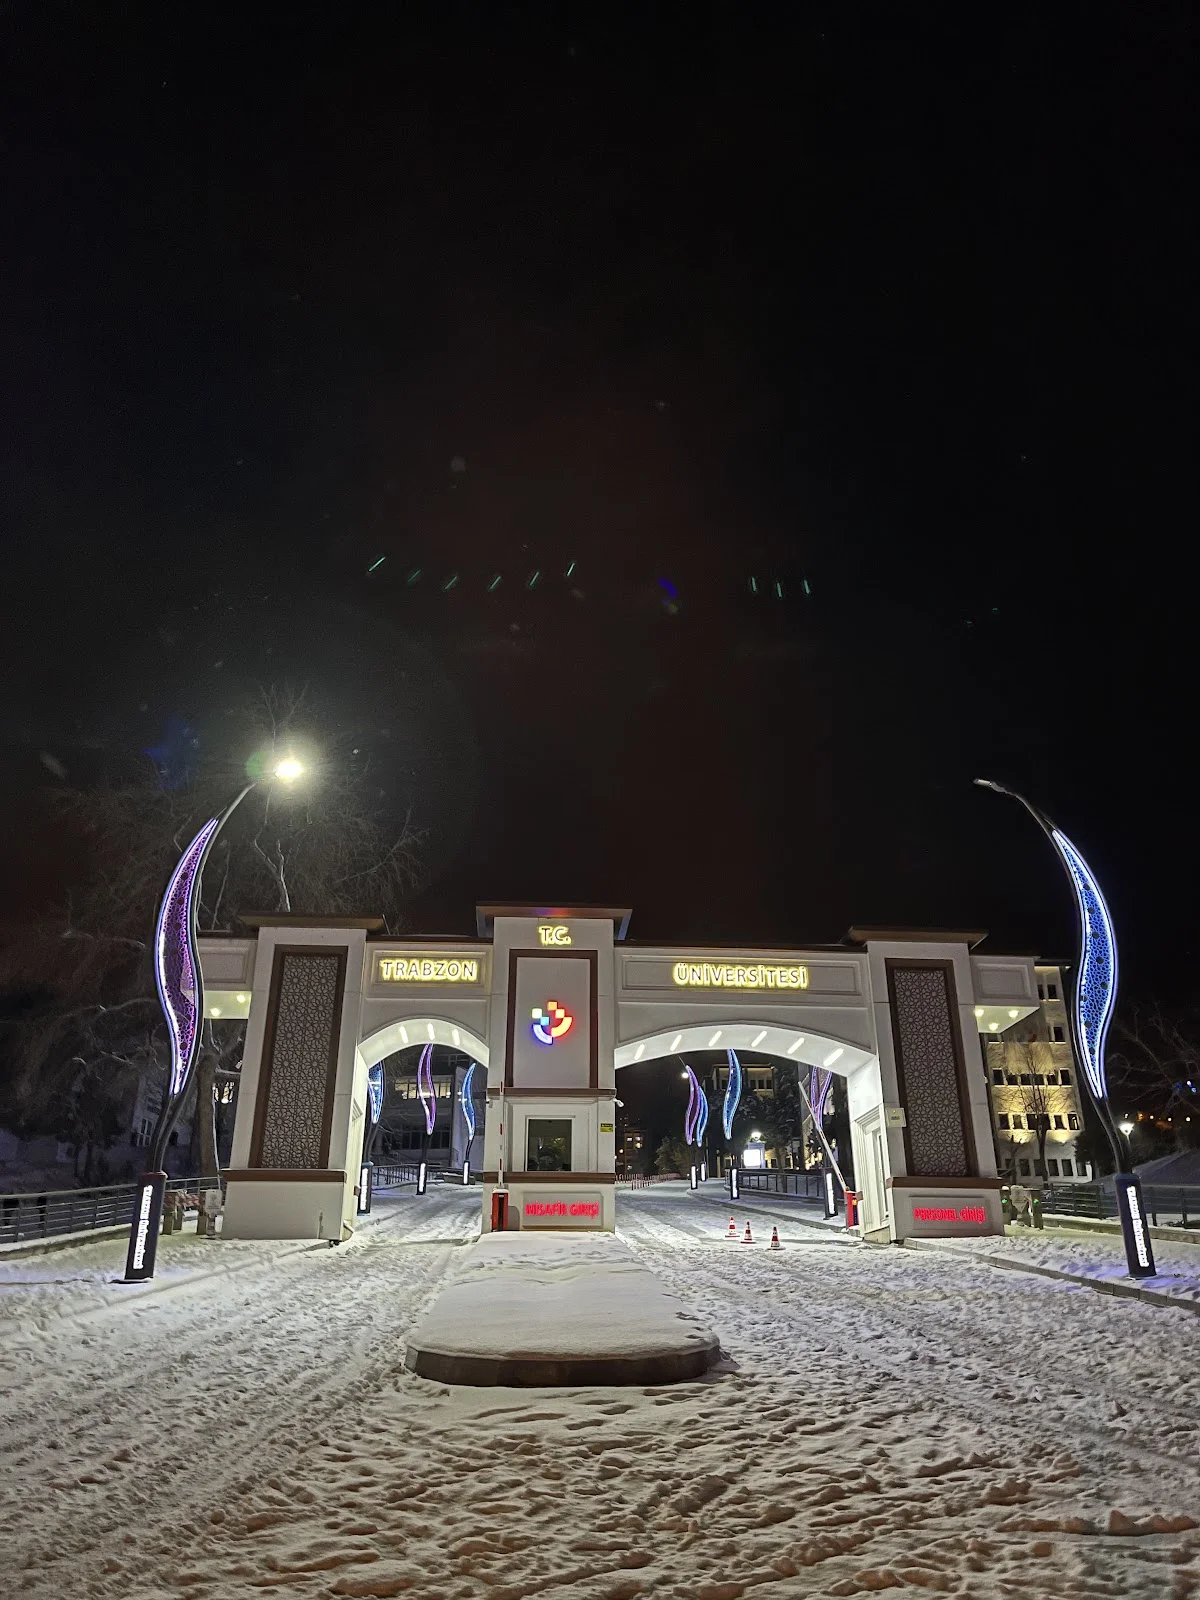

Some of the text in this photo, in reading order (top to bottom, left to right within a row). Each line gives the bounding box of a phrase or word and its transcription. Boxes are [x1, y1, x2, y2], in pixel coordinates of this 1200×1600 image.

[538, 925, 571, 945] T.C.
[379, 959, 478, 981] TRABZON
[673, 962, 808, 989] ÜNİVERSİTESİ
[569, 1200, 599, 1219] GİRİŞİ
[913, 1205, 986, 1224] PERSONEL GİRİŞİ
